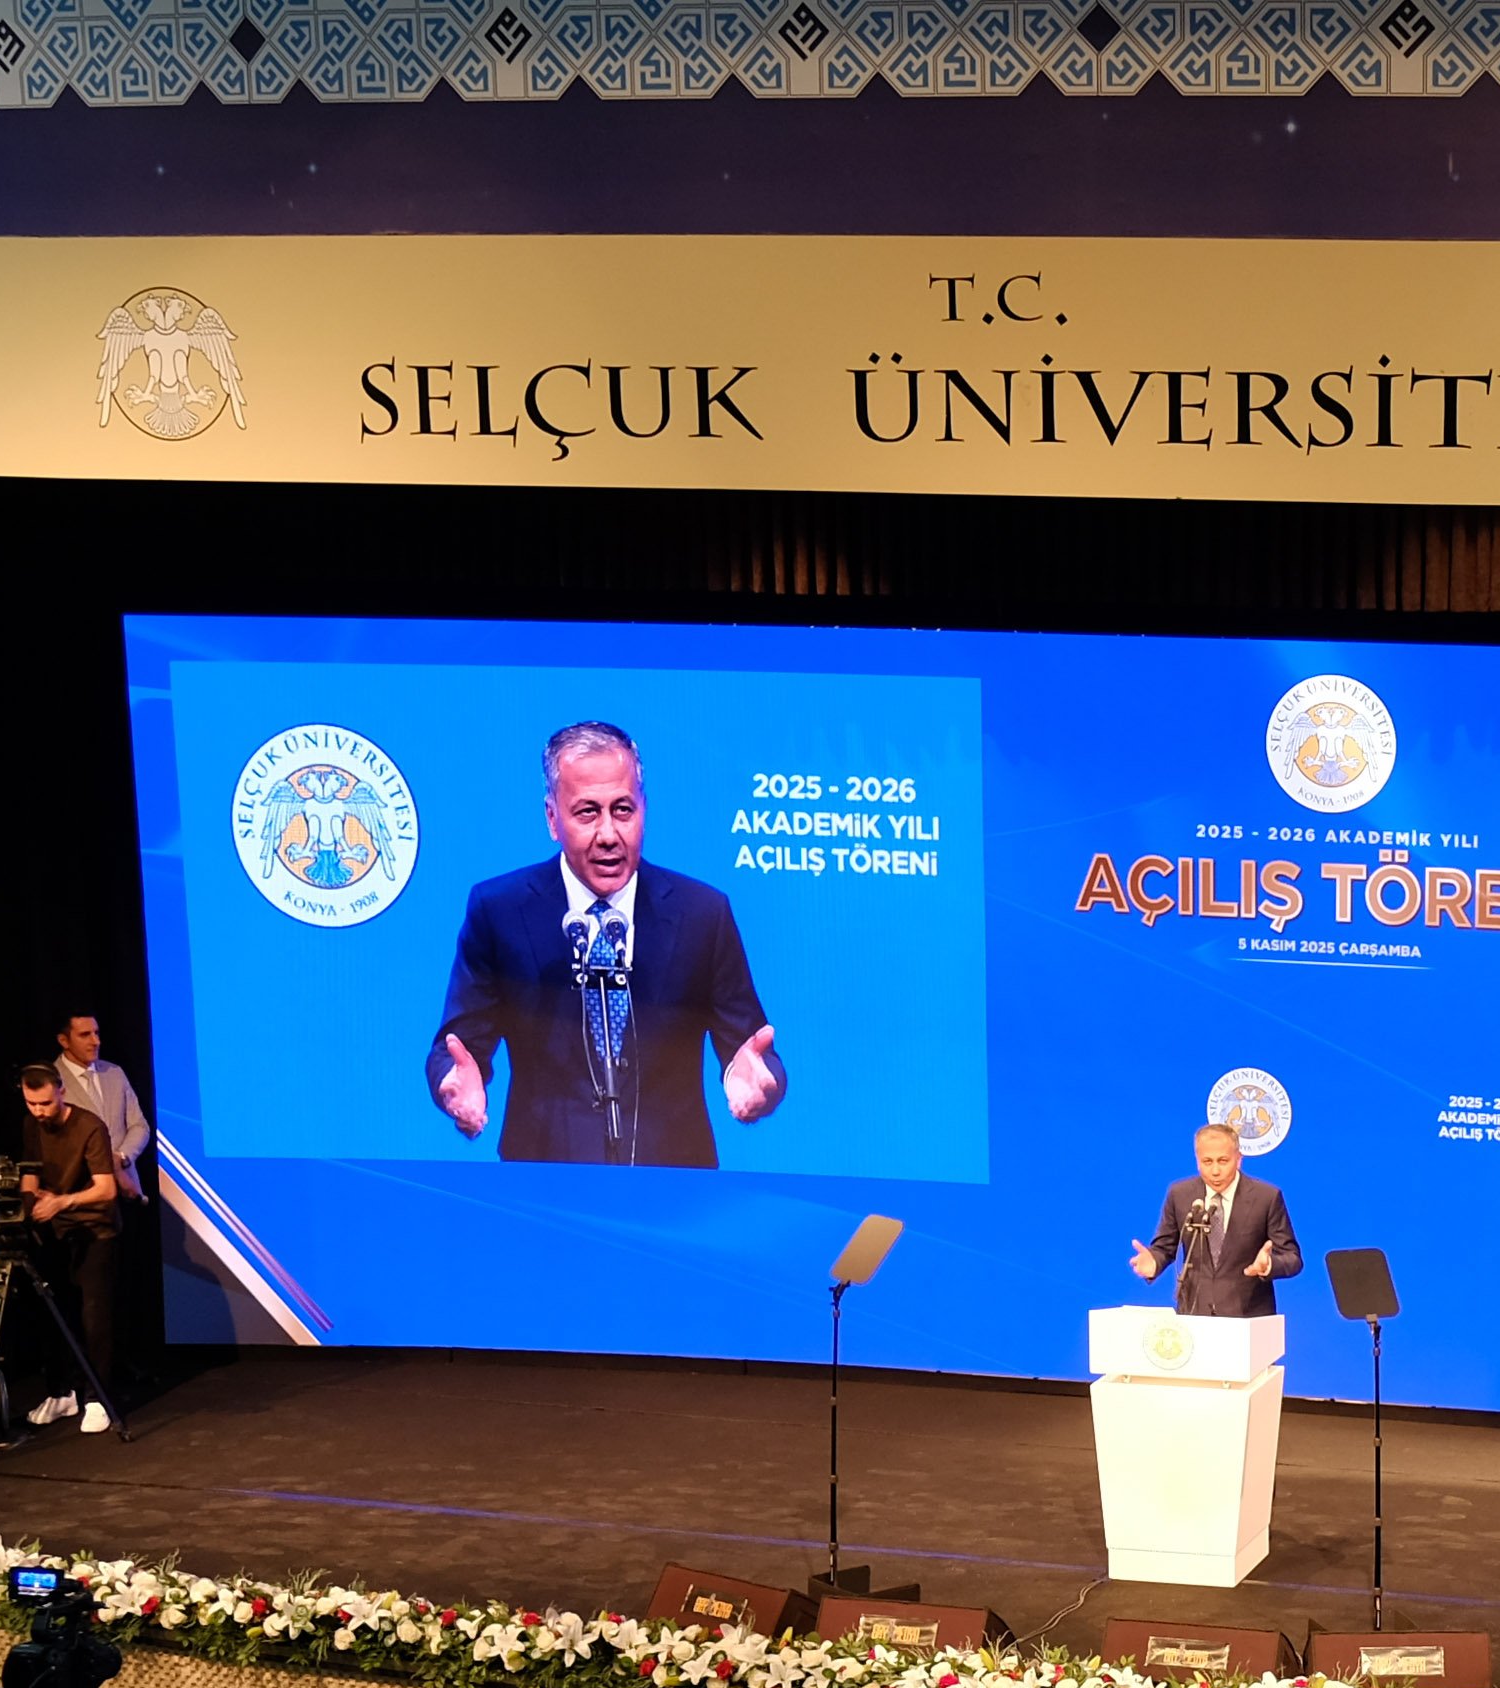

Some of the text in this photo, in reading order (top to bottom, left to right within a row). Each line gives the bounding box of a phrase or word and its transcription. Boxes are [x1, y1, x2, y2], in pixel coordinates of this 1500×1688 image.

[929, 271, 1068, 326] T.C.
[360, 356, 764, 462] SELÇUK
[238, 747, 282, 838] SELÇUK
[752, 773, 822, 800] 2025
[846, 777, 916, 803] 2026
[731, 809, 940, 841] AKADEMİK YILI
[1196, 824, 1243, 839] 2025
[1268, 827, 1316, 842] 2026
[1325, 828, 1431, 847] AKADEMİK
[1440, 833, 1479, 849] YILI
[734, 842, 938, 877] AÇILIŞ TÖRENİ
[284, 890, 337, 916] KONYA
[350, 891, 379, 914] 1908
[1075, 853, 1303, 933] AÇILIŞ
[1238, 938, 1422, 958] 5 KASIM 2025 ÇARŞAMBA
[1449, 1095, 1483, 1109] 2025
[1438, 1126, 1483, 1142] AÇILIŞ
